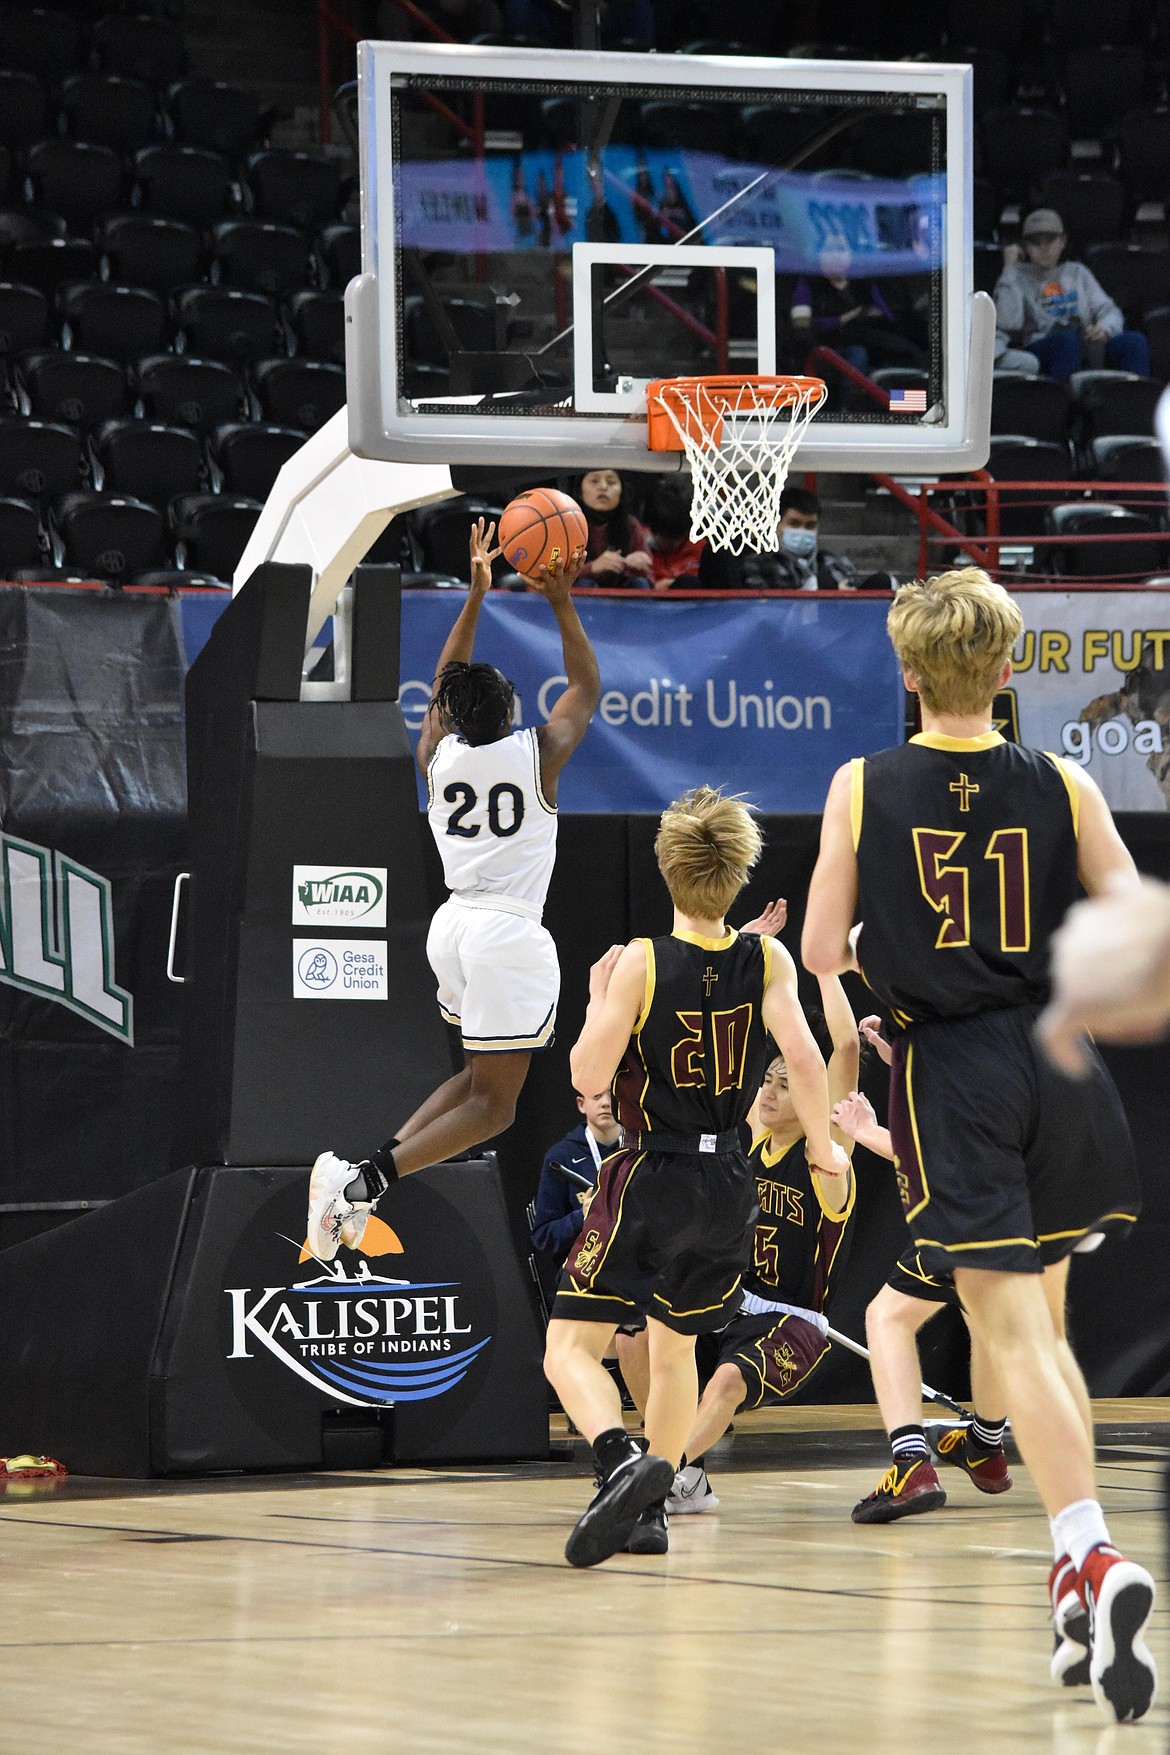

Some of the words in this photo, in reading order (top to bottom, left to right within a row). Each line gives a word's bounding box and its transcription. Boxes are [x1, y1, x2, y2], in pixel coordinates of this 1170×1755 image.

[538, 675, 693, 727] Cedit
[707, 679, 831, 729] Union
[444, 782, 525, 838] 20
[312, 883, 370, 904] WIAA
[912, 828, 1030, 952] 51
[343, 951, 375, 963] Gesa
[343, 964, 384, 976] Credit
[343, 977, 379, 989] Union
[671, 1003, 752, 1095] 20
[224, 1287, 472, 1408] KALISPEL
[300, 1343, 347, 1357] TRIBE
[353, 1342, 375, 1355] OF
[381, 1339, 451, 1353] INDIANS
